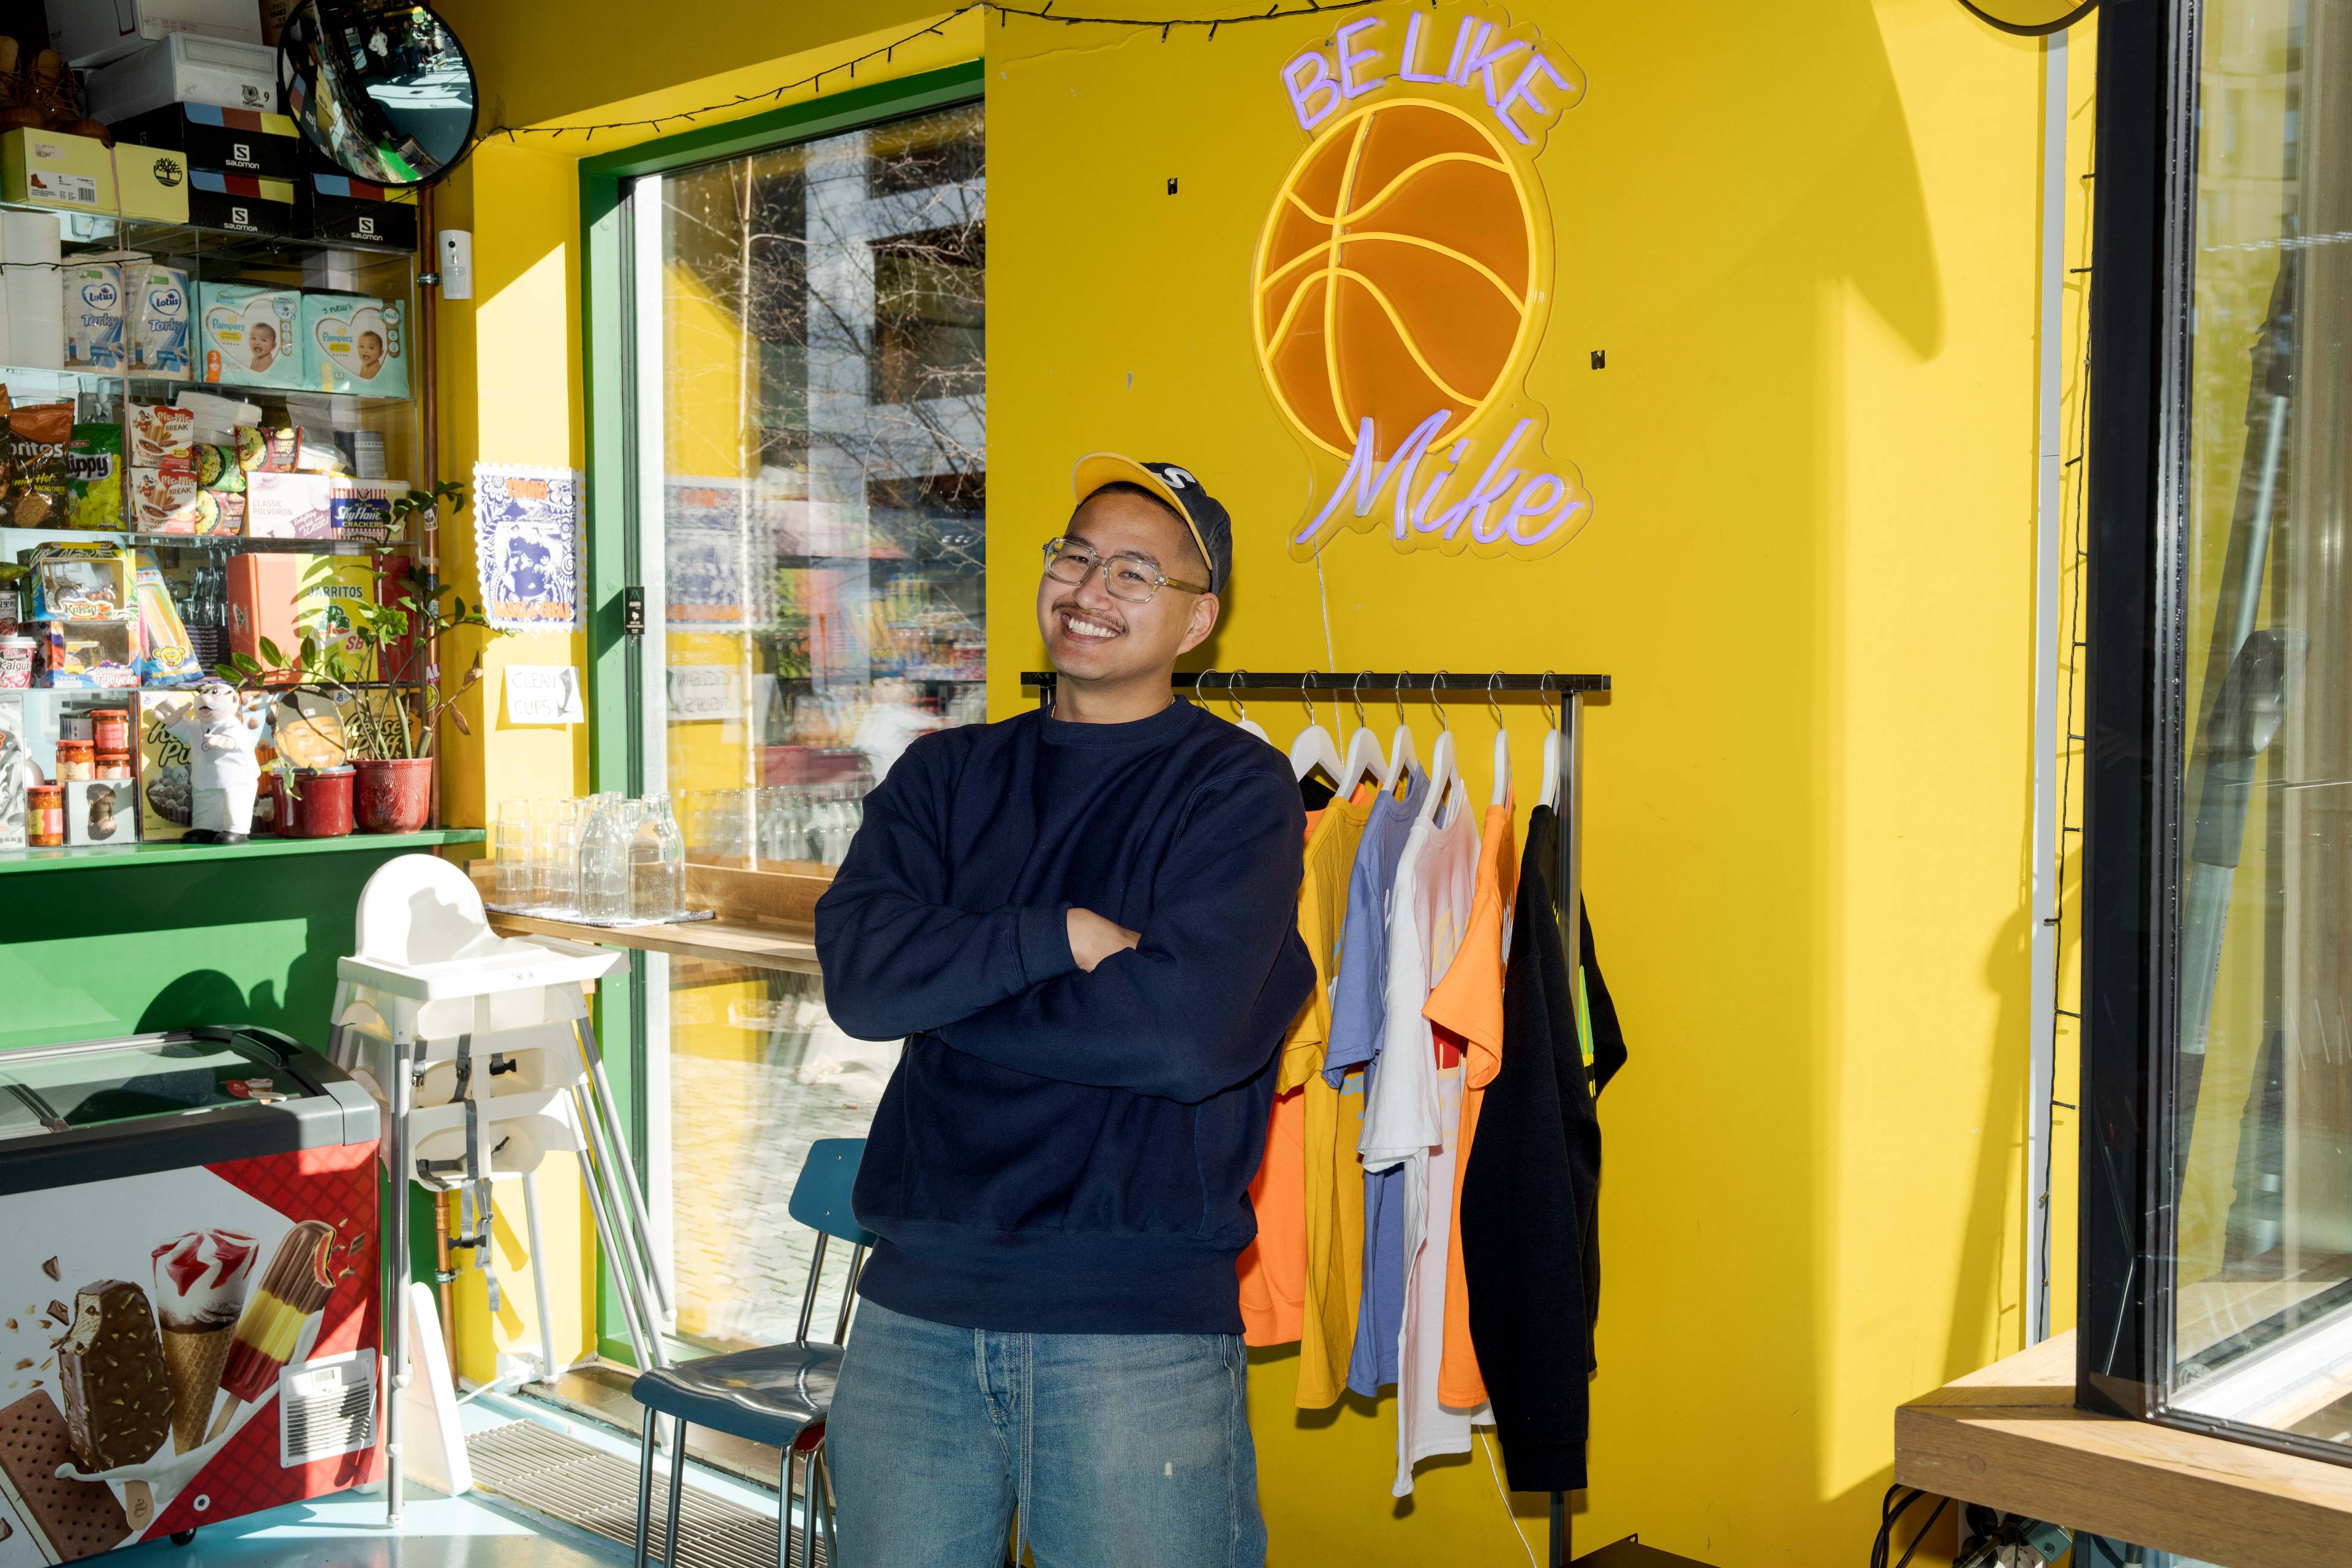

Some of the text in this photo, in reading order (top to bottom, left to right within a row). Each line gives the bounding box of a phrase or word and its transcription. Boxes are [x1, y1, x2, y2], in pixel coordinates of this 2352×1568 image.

[1283, 11, 1569, 145] BE LIKE
[263, 91, 270, 102] 9
[89, 292, 113, 301] Lotus
[156, 298, 179, 307] Lotus
[330, 304, 348, 314] new
[81, 313, 118, 329] Torky
[148, 318, 183, 333] Torky
[212, 318, 246, 331] Pampers
[322, 331, 353, 343] Pampers
[10, 442, 64, 458] oritos
[67, 454, 108, 478] ippy
[1152, 467, 1196, 489] S
[1296, 409, 1580, 546] Mike
[252, 499, 283, 508] CLASSIC
[252, 507, 292, 516] POLVORON
[306, 586, 363, 598] JARRITOS
[64, 604, 97, 614] Kalesa
[345, 635, 365, 651] SB
[512, 672, 556, 688] CLEAN
[514, 699, 551, 715] CUPS
